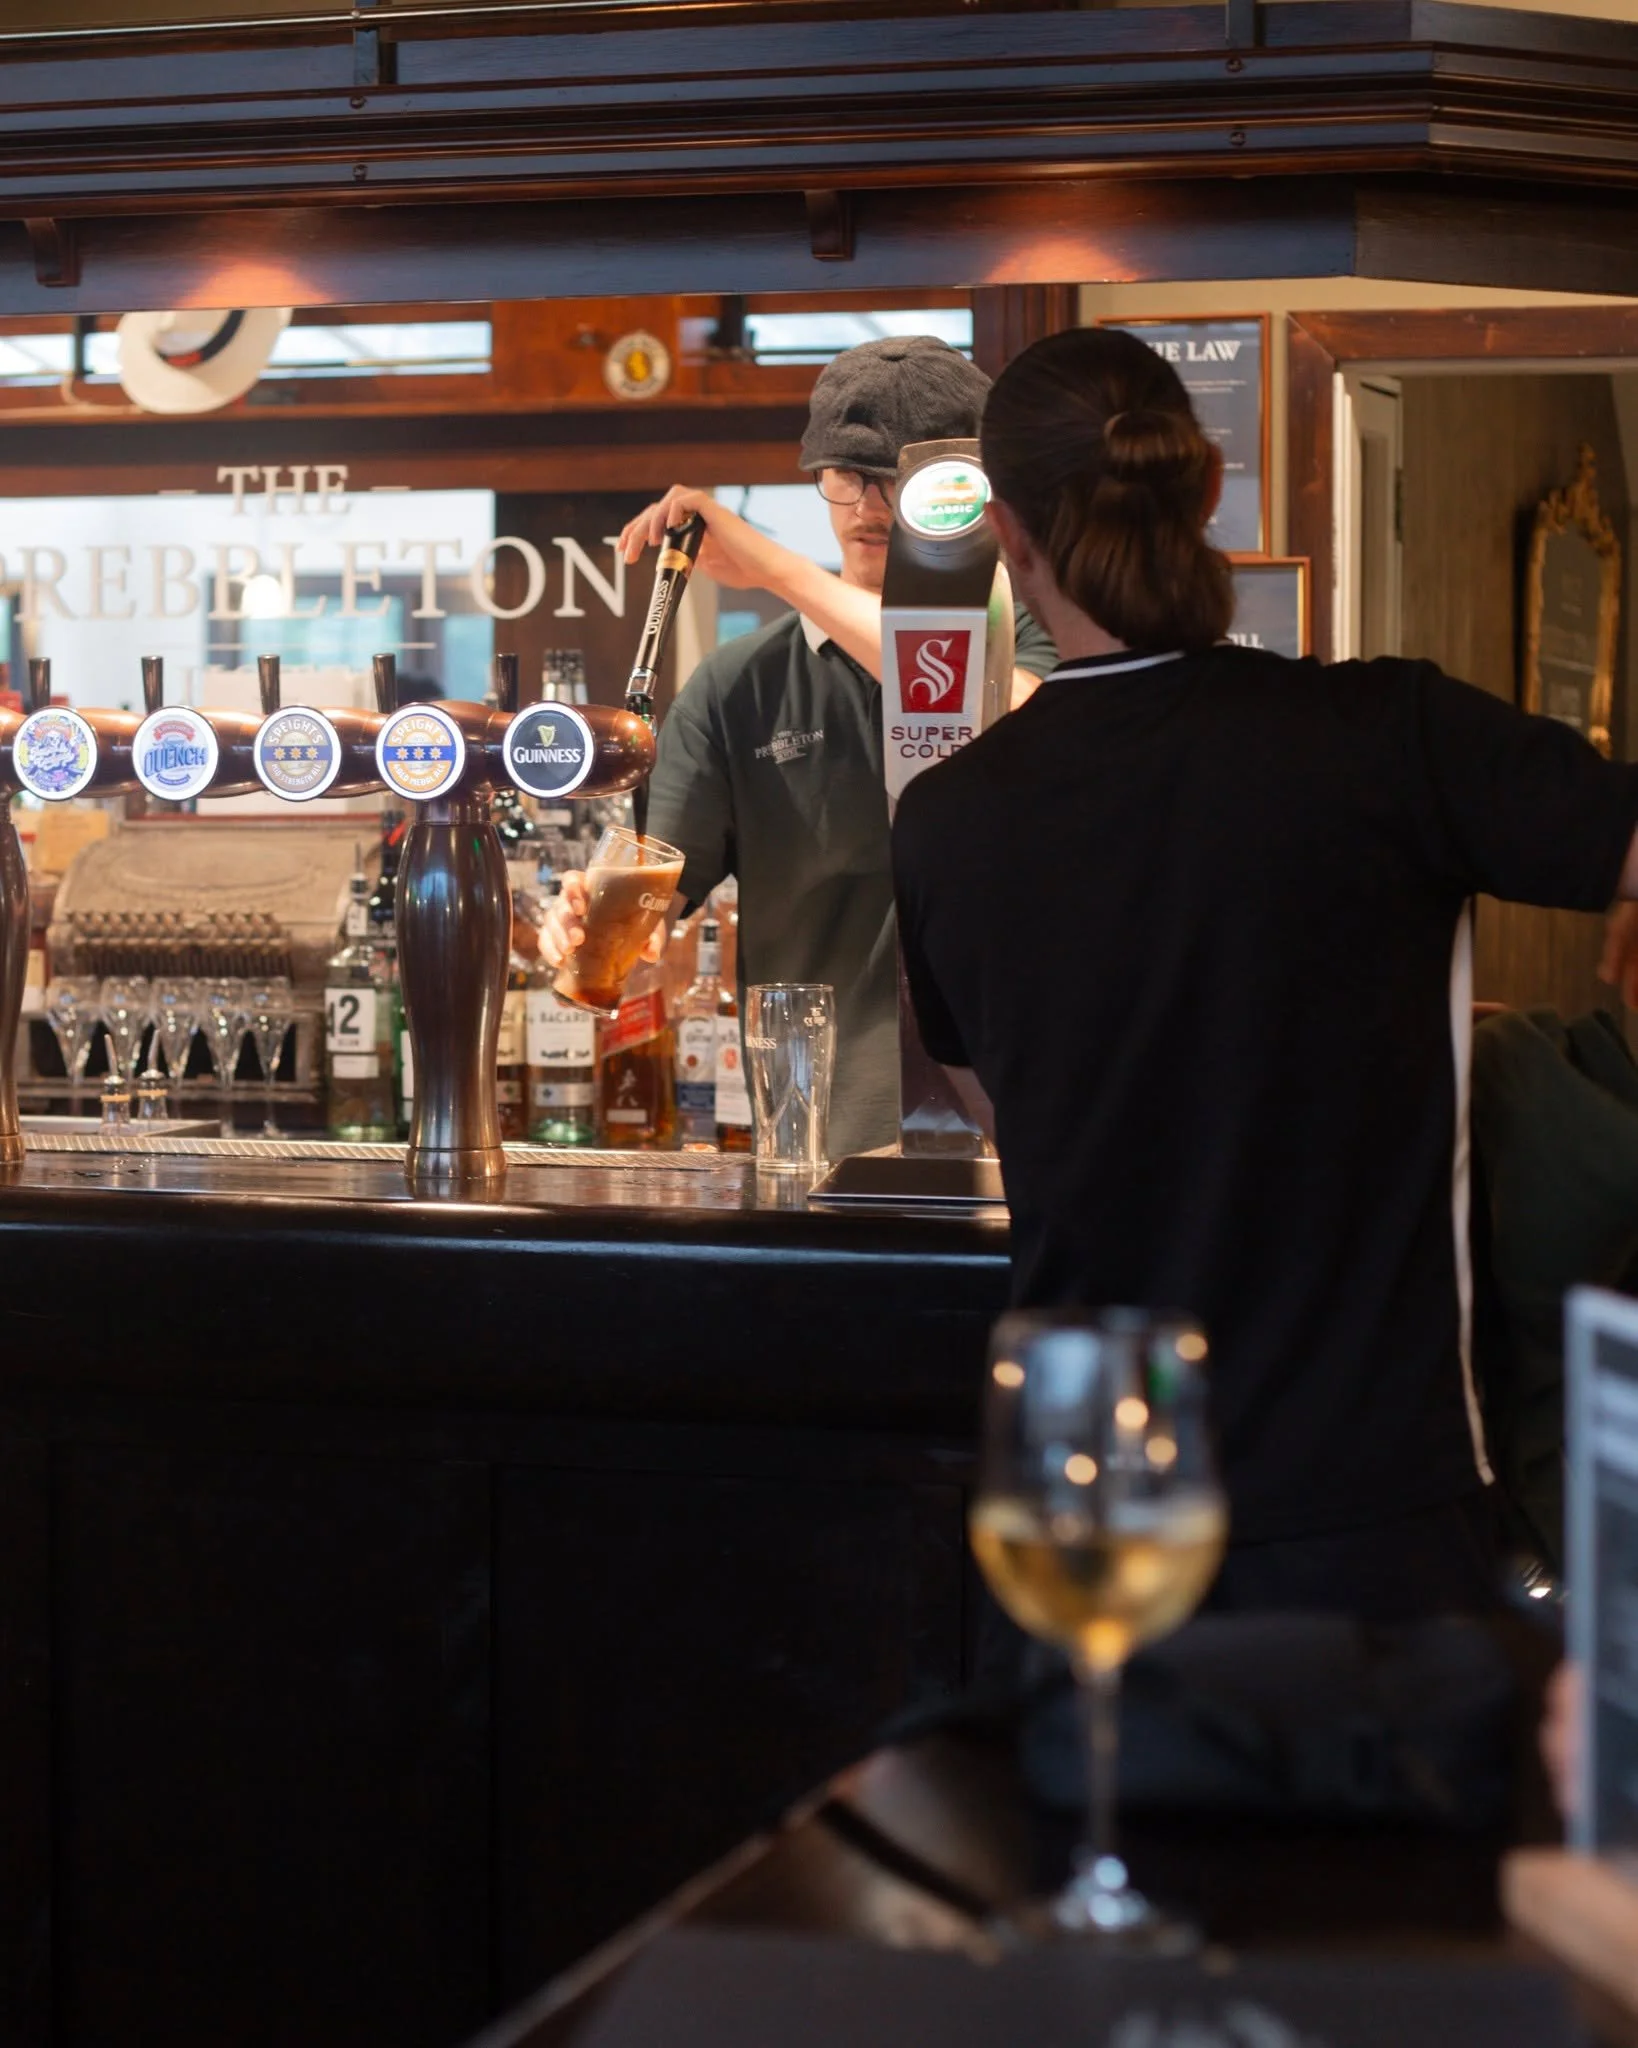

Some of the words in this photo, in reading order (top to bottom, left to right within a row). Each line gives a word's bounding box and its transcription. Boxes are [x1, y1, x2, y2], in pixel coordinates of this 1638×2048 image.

[1186, 340, 1241, 362] LAW
[216, 464, 352, 516] THE
[0, 535, 627, 621] REBBLETON
[647, 579, 670, 635] GUINNESS
[891, 726, 973, 741] SUPER
[144, 744, 208, 778] QUENCH
[513, 746, 582, 764] GUINNESS
